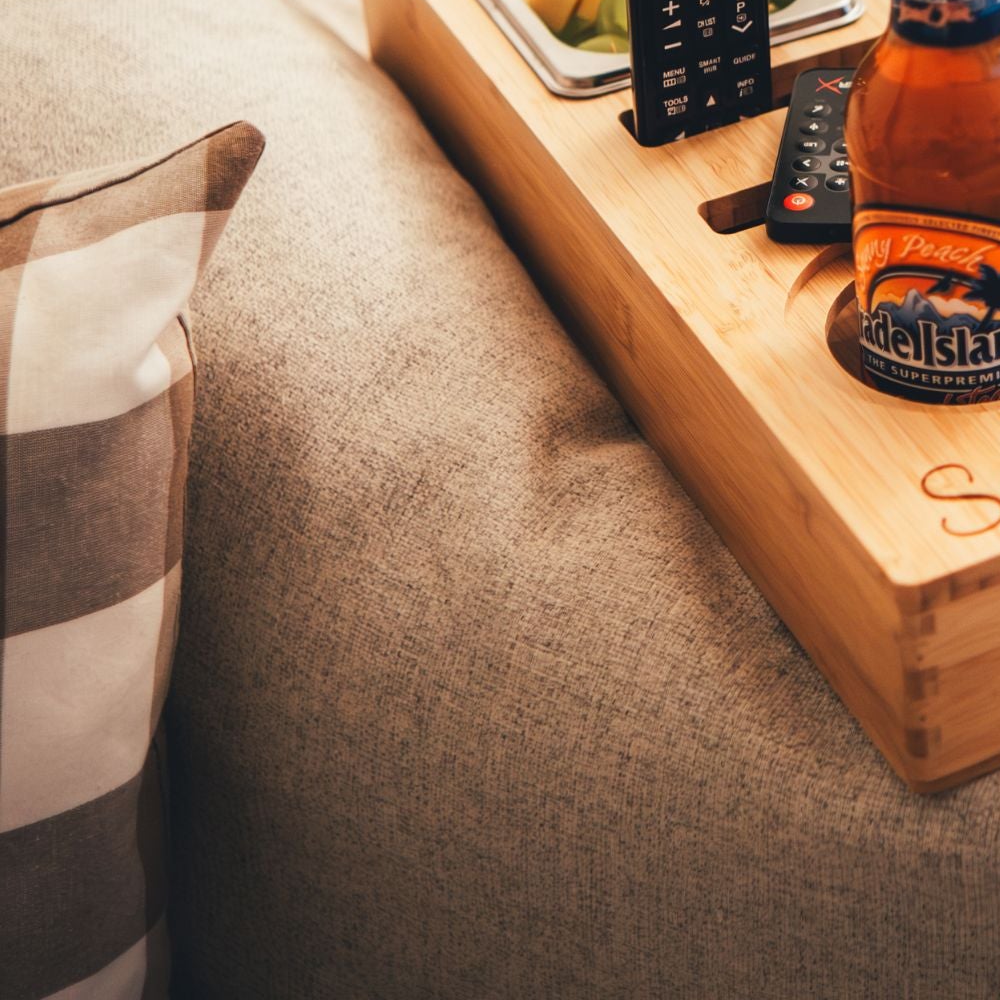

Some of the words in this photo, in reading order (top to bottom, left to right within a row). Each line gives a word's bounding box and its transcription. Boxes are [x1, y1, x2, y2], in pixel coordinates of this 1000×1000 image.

[736, 1, 746, 13] P
[698, 56, 721, 68] SMART
[733, 53, 756, 65] GUIDE
[663, 67, 686, 78] MENU
[737, 78, 755, 89] INFO
[663, 95, 688, 108] TOOLS
[900, 234, 997, 273] Peach
[867, 353, 885, 370] THE
